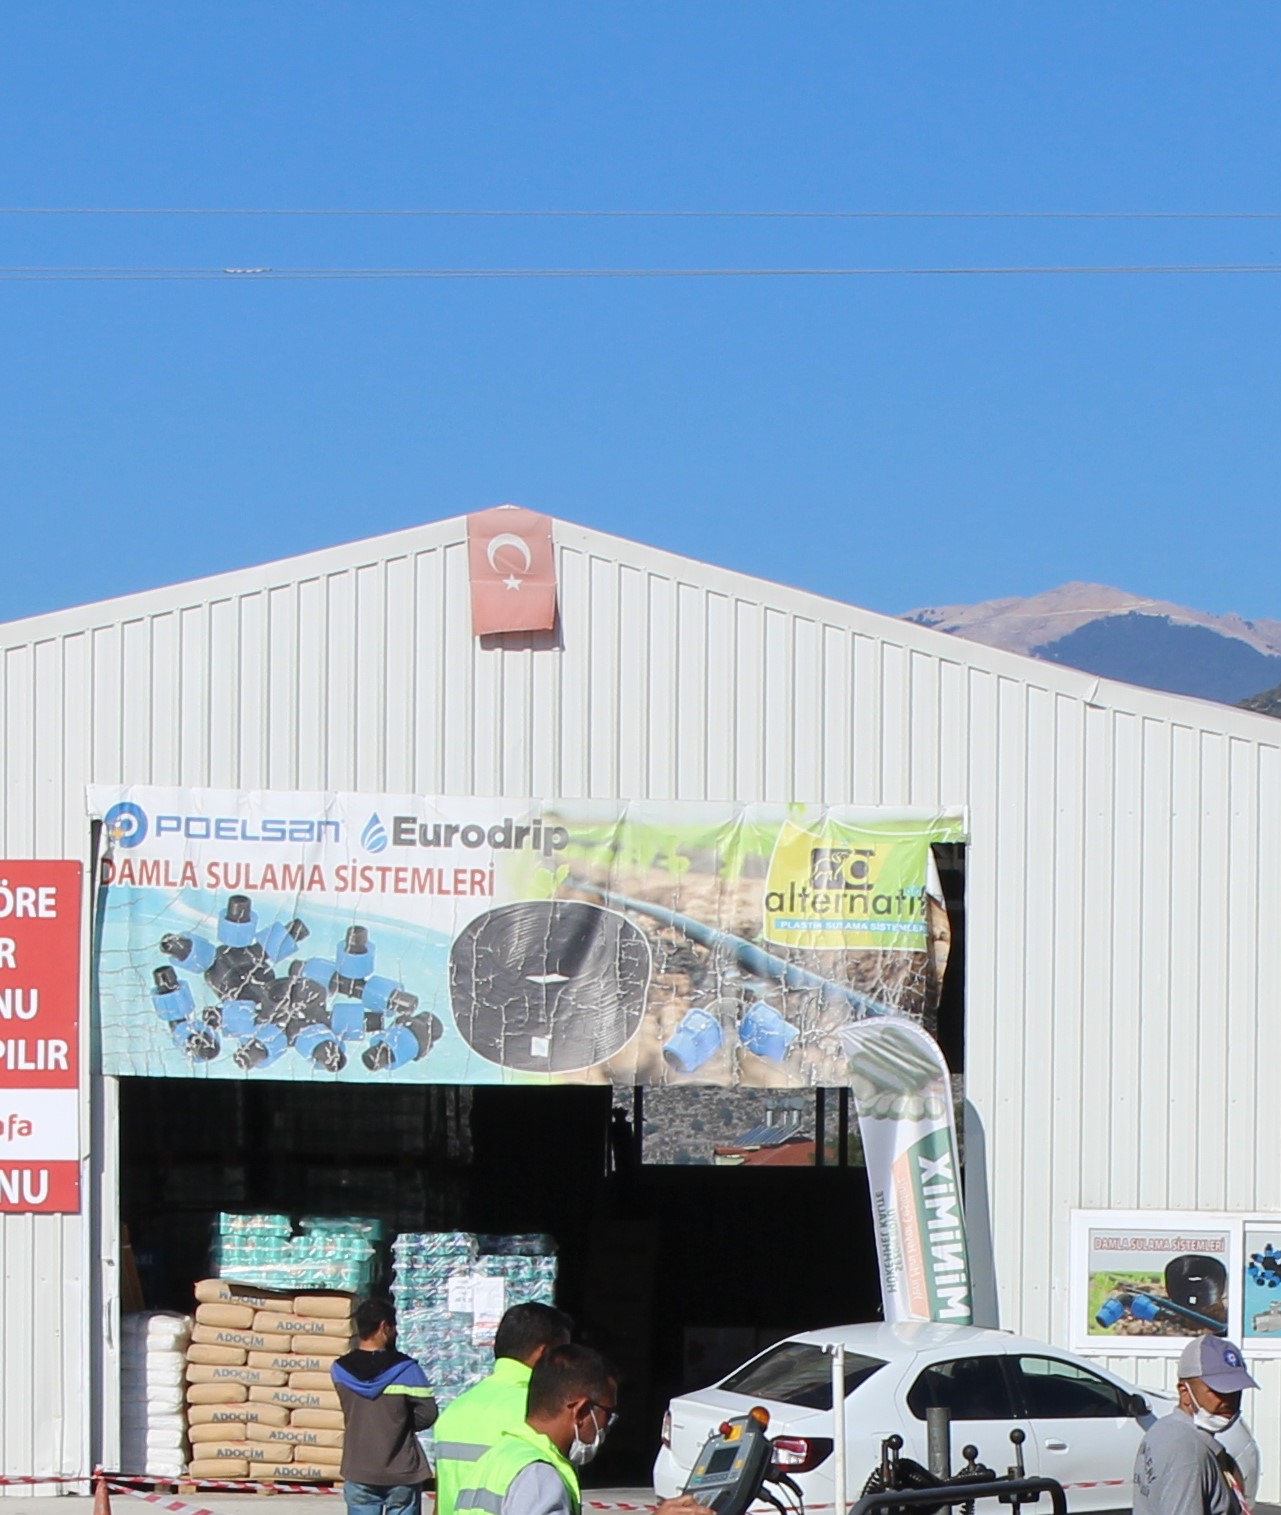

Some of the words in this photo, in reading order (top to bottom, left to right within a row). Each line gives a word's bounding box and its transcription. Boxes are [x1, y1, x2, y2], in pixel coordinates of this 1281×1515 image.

[392, 816, 570, 857] Eurodrip
[100, 857, 198, 888] DAMLA
[206, 861, 327, 893] SULAMA
[334, 858, 496, 897] SİSTEMLERİ
[1131, 1238, 1171, 1251] SULAMA
[276, 1320, 325, 1334] ADOÇİM
[215, 1332, 265, 1347] ADOÇİM
[271, 1357, 320, 1369] ADOÇİM
[212, 1368, 260, 1381] ADOÇİM
[272, 1391, 320, 1406] ADOÇİM
[211, 1411, 259, 1423] ADOÇİM
[268, 1430, 317, 1443] ADOÇİM
[216, 1448, 265, 1459] ADOÇİM
[273, 1465, 322, 1479] ADOÇİM
